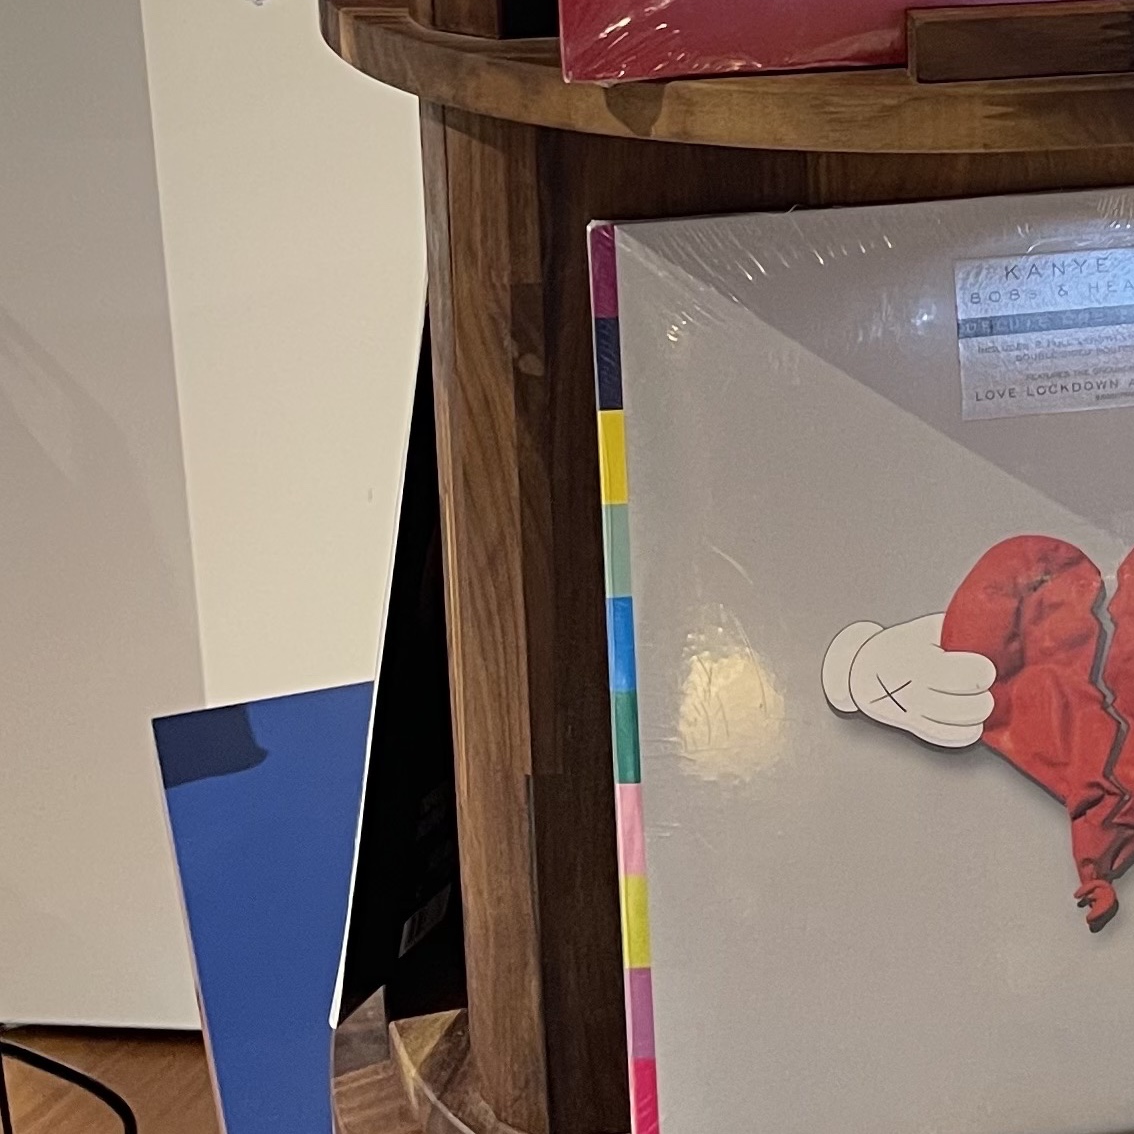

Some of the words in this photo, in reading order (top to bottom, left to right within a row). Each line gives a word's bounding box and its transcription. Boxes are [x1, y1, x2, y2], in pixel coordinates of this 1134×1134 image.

[1004, 257, 1111, 281] KANYE
[1057, 283, 1069, 298] &
[975, 387, 1017, 403] LOVE
[1026, 378, 1121, 398] LOCKDOWN
